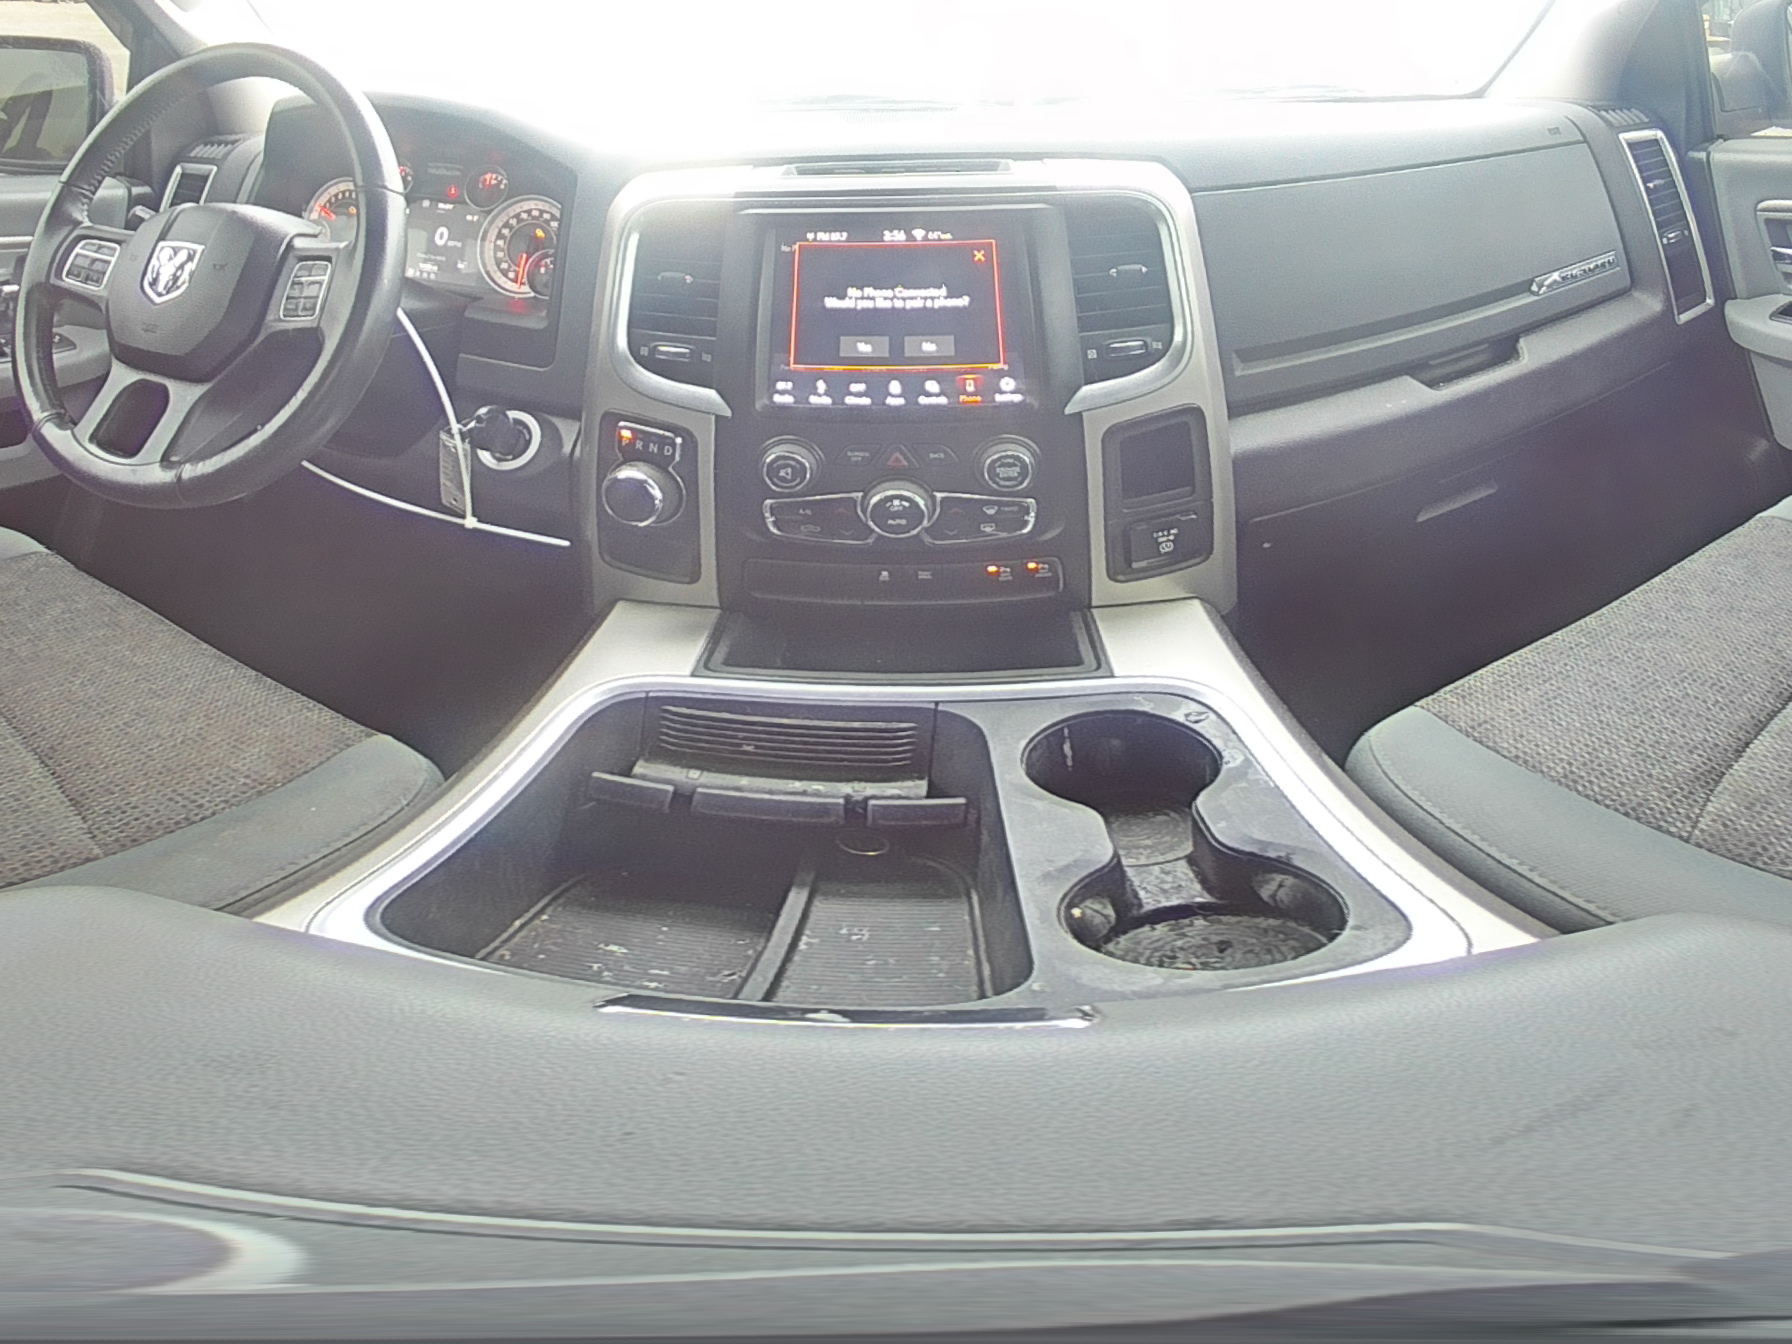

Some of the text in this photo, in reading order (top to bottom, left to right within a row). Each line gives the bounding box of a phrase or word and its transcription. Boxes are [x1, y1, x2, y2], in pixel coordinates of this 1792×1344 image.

[434, 226, 449, 246] 0
[635, 442, 644, 451] R
[648, 444, 659, 454] N
[663, 446, 673, 456] D
